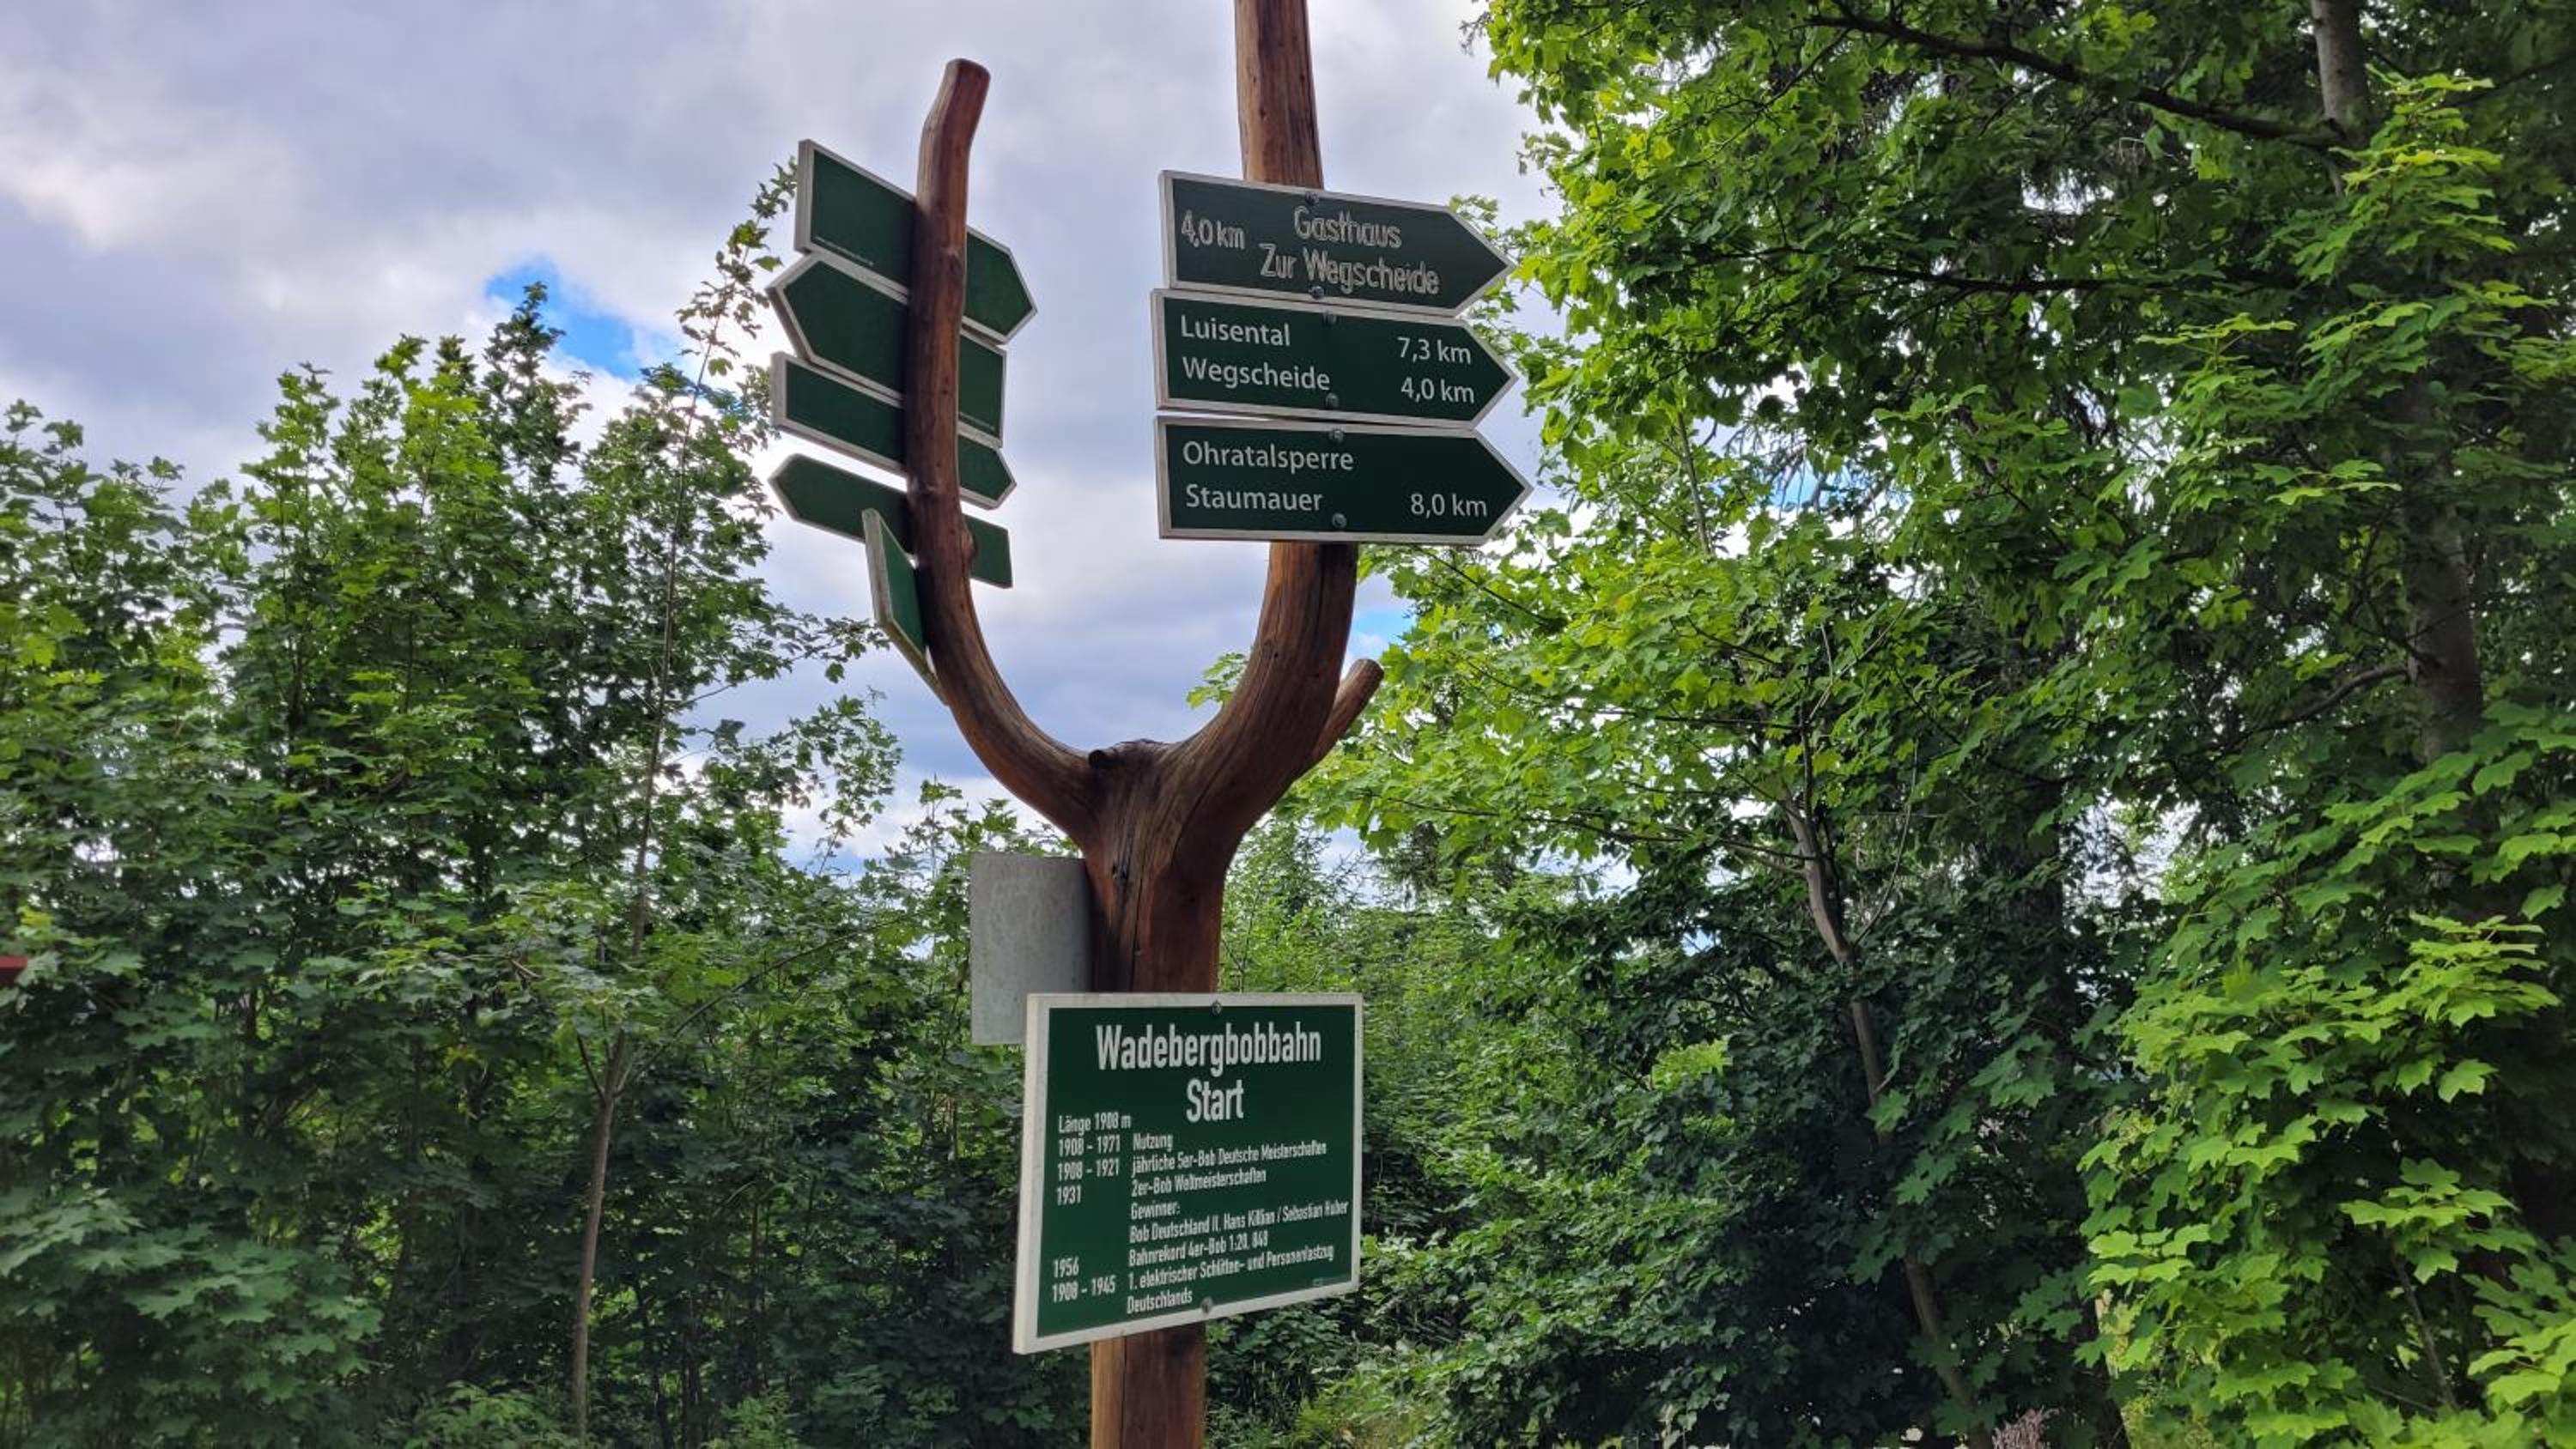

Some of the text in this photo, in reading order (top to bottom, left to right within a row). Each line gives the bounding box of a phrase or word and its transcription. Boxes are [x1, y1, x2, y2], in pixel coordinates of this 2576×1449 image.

[1182, 209, 1245, 250] 4,0 km
[1294, 205, 1401, 249] Gasthaus
[1258, 243, 1439, 294] Zur Wegscheide
[1181, 314, 1471, 364] Luisental 7,3 km
[1182, 357, 1474, 403] Wegscheide 4,0 km
[1183, 440, 1354, 474] Ohratalsperre
[1186, 484, 1487, 518] Staumauer 8,0 km
[1097, 1021, 1321, 1076] Wadebergbobbahn
[1187, 1078, 1244, 1123] Start
[1059, 1113, 1132, 1136] Länge 1908 m
[1059, 1137, 1084, 1157] 1908
[1097, 1134, 1121, 1154] 1971
[1133, 1133, 1173, 1152] Nutzung
[1058, 1161, 1084, 1181] 1908
[1096, 1157, 1120, 1177] 1921
[1132, 1154, 1175, 1179] jährliche
[1177, 1149, 1216, 1170] 5er-Bob
[1218, 1145, 1260, 1165] Deutsche
[1261, 1140, 1327, 1161] Meisterschaften
[1056, 1167, 1267, 1206] 1931 2er-Bob Weltmeisterschaften
[1129, 1225, 1150, 1243] Bob
[1151, 1216, 1209, 1240] Deutschland
[1224, 1213, 1245, 1230] Hans
[1282, 1203, 1323, 1222] Sebastian
[1131, 1201, 1181, 1220] Gewinner:
[1052, 1281, 1078, 1303] 1908
[1091, 1275, 1116, 1296] 1945
[1128, 1272, 1137, 1290] 1.
[1139, 1266, 1197, 1288] elektrischer
[1247, 1252, 1264, 1270] und
[1267, 1245, 1334, 1268] Personenlastzug
[1053, 1257, 1079, 1278] 1956
[1128, 1242, 1186, 1267] Bahnrekord
[1188, 1236, 1226, 1258] 4er-Bob
[1127, 1288, 1192, 1314] Deutschlands
